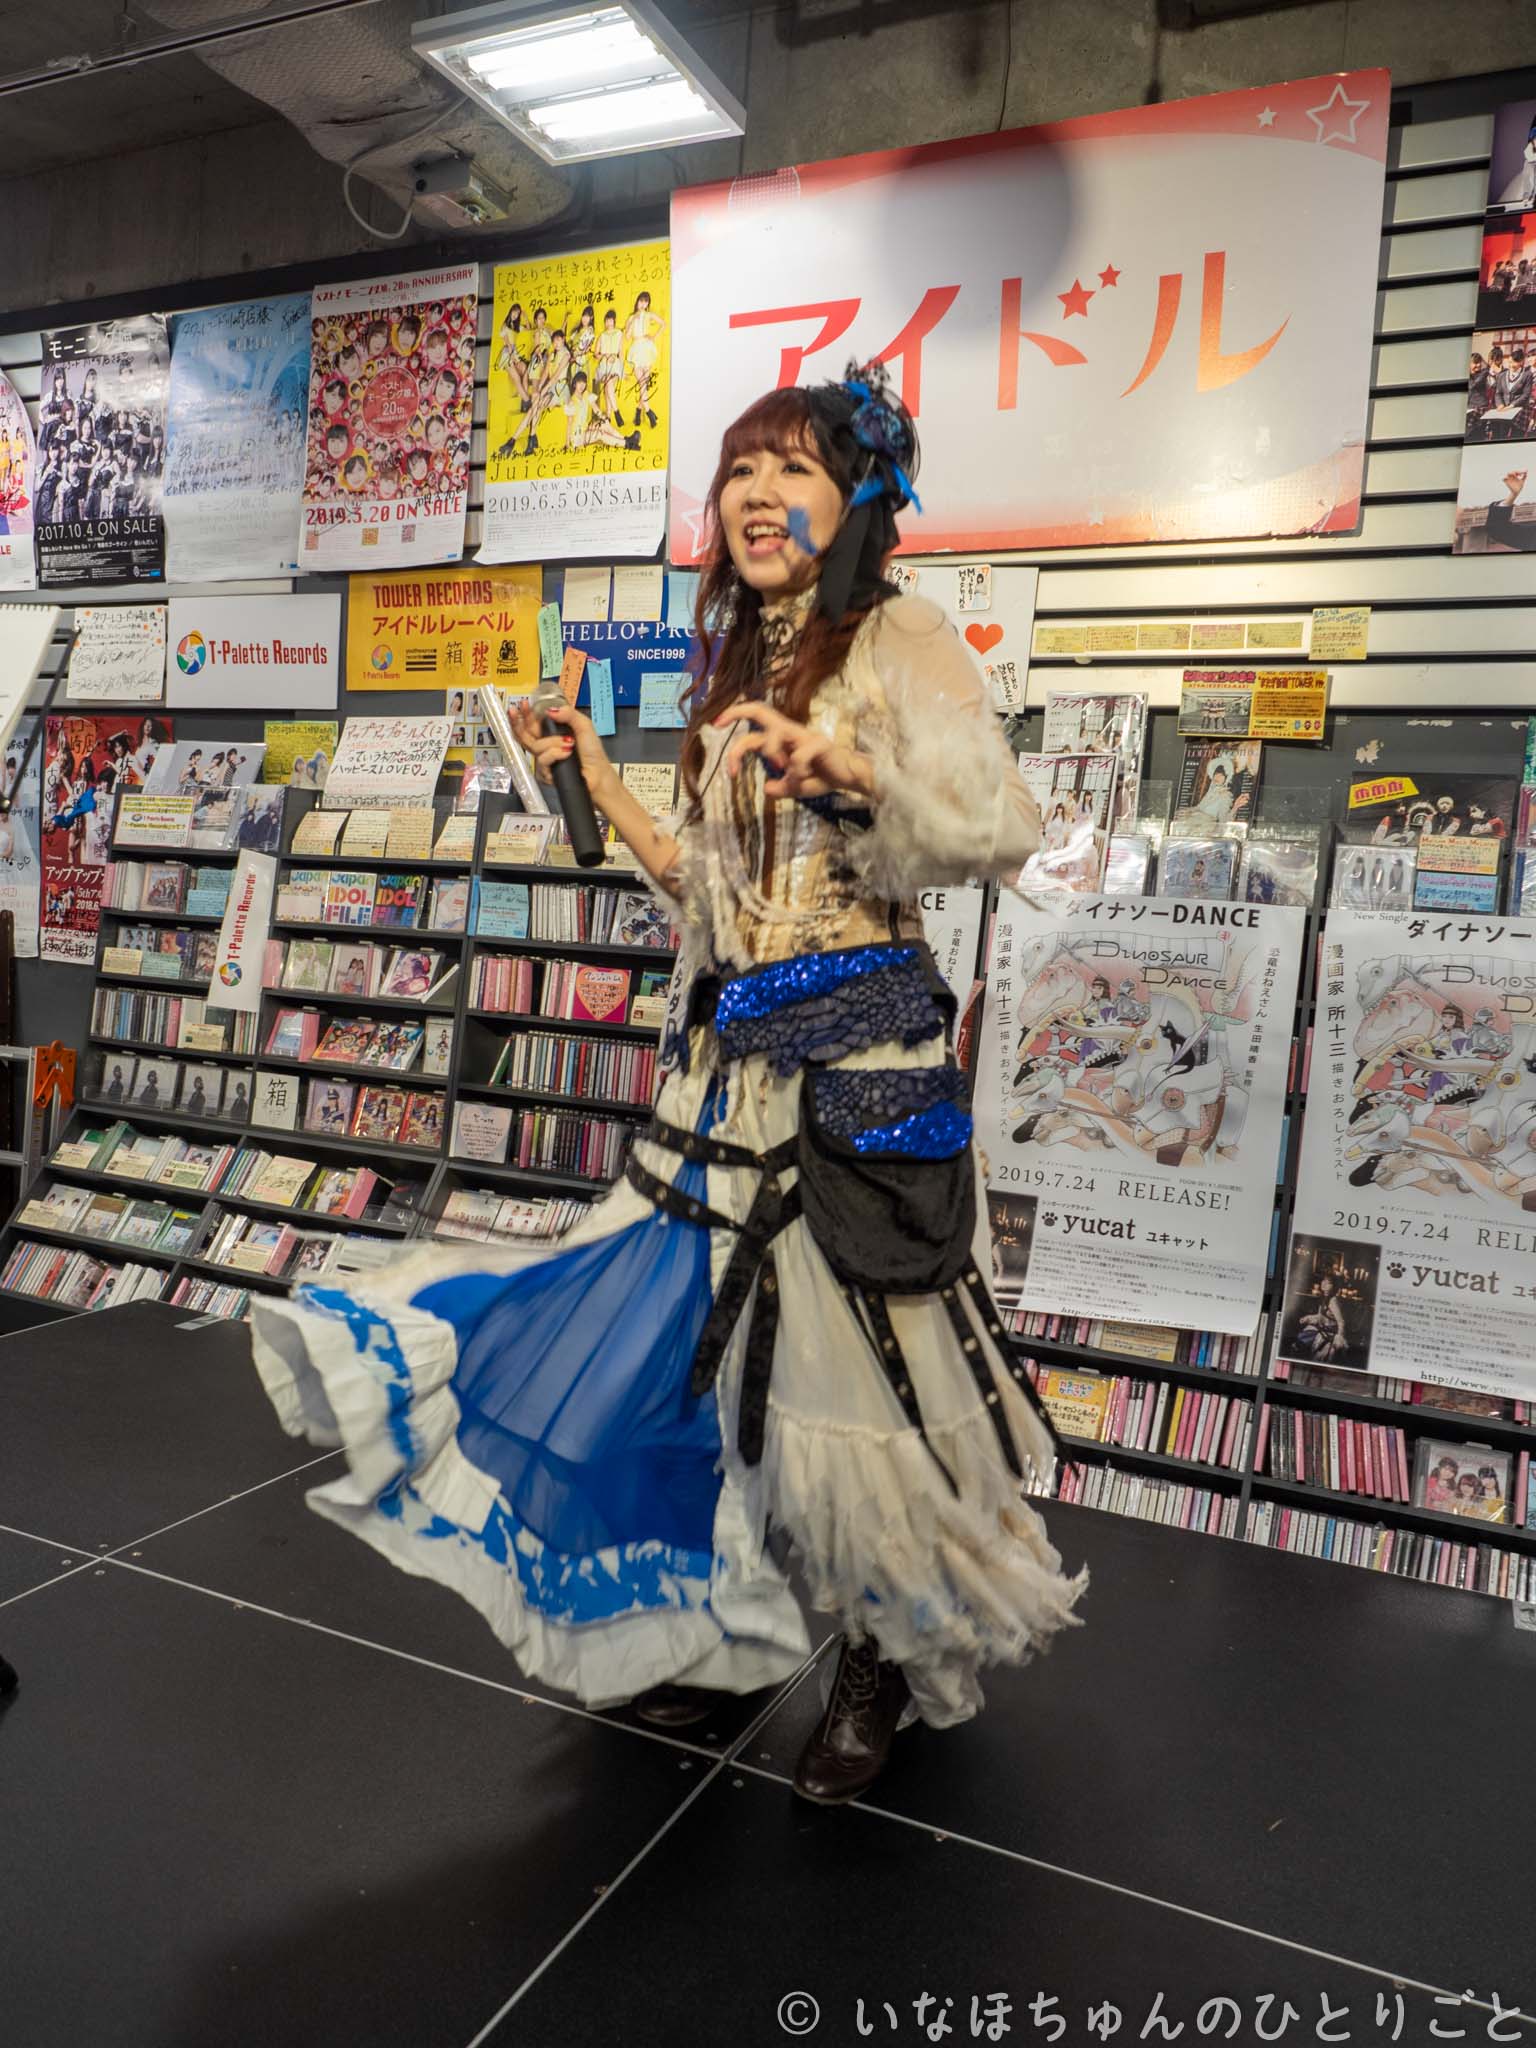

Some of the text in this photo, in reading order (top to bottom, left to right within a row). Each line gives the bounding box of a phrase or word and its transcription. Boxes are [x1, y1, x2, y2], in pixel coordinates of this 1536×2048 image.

[729, 251, 1292, 418] アイドル
[529, 476, 616, 493] New Single
[488, 492, 568, 514] 2019.6.5
[576, 490, 604, 508] ON
[609, 485, 662, 506] SALE
[38, 517, 157, 542] 2017.10.4 ON SALE
[373, 579, 493, 609] TOWER RECORDS
[372, 610, 515, 636] アイドルレーベル
[208, 640, 328, 665] T-Palette Records
[328, 886, 372, 906] IDOL
[376, 888, 417, 908] IDOL
[325, 904, 371, 926] FILE
[372, 906, 416, 928] FILE
[1379, 912, 1409, 924] Single
[266, 1078, 288, 1108] 箱
[998, 1165, 1097, 1194] 2019.7.24
[1117, 1179, 1231, 1211] RELEASE!
[1062, 1213, 1209, 1250] yucat ユキャット
[1333, 1211, 1449, 1241] 2019.7.24
[1412, 1264, 1500, 1294] yucat
